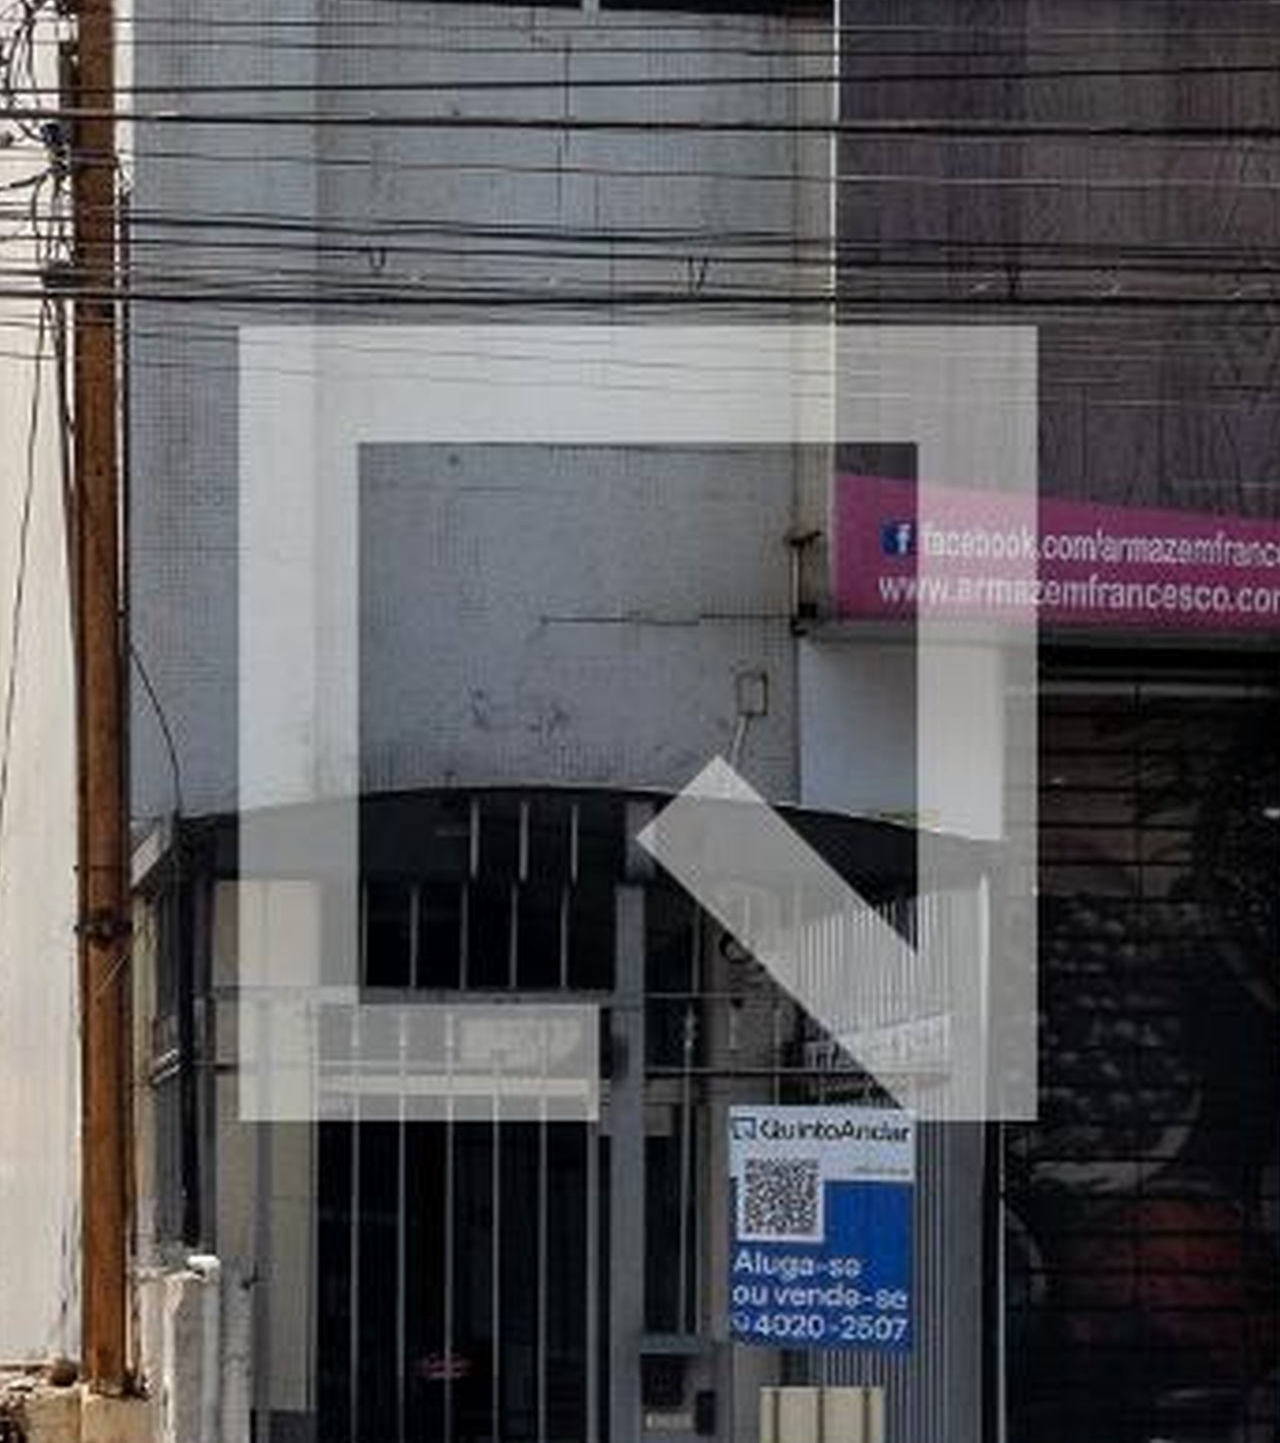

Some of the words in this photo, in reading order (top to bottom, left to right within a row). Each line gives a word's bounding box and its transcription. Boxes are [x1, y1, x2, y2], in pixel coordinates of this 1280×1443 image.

[760, 1119, 911, 1142] QuintoAndar
[732, 1250, 862, 1283] Aluga-se
[732, 1284, 769, 1306] ou
[774, 1280, 909, 1310] vende-se
[753, 1313, 909, 1341] 4020-2507
